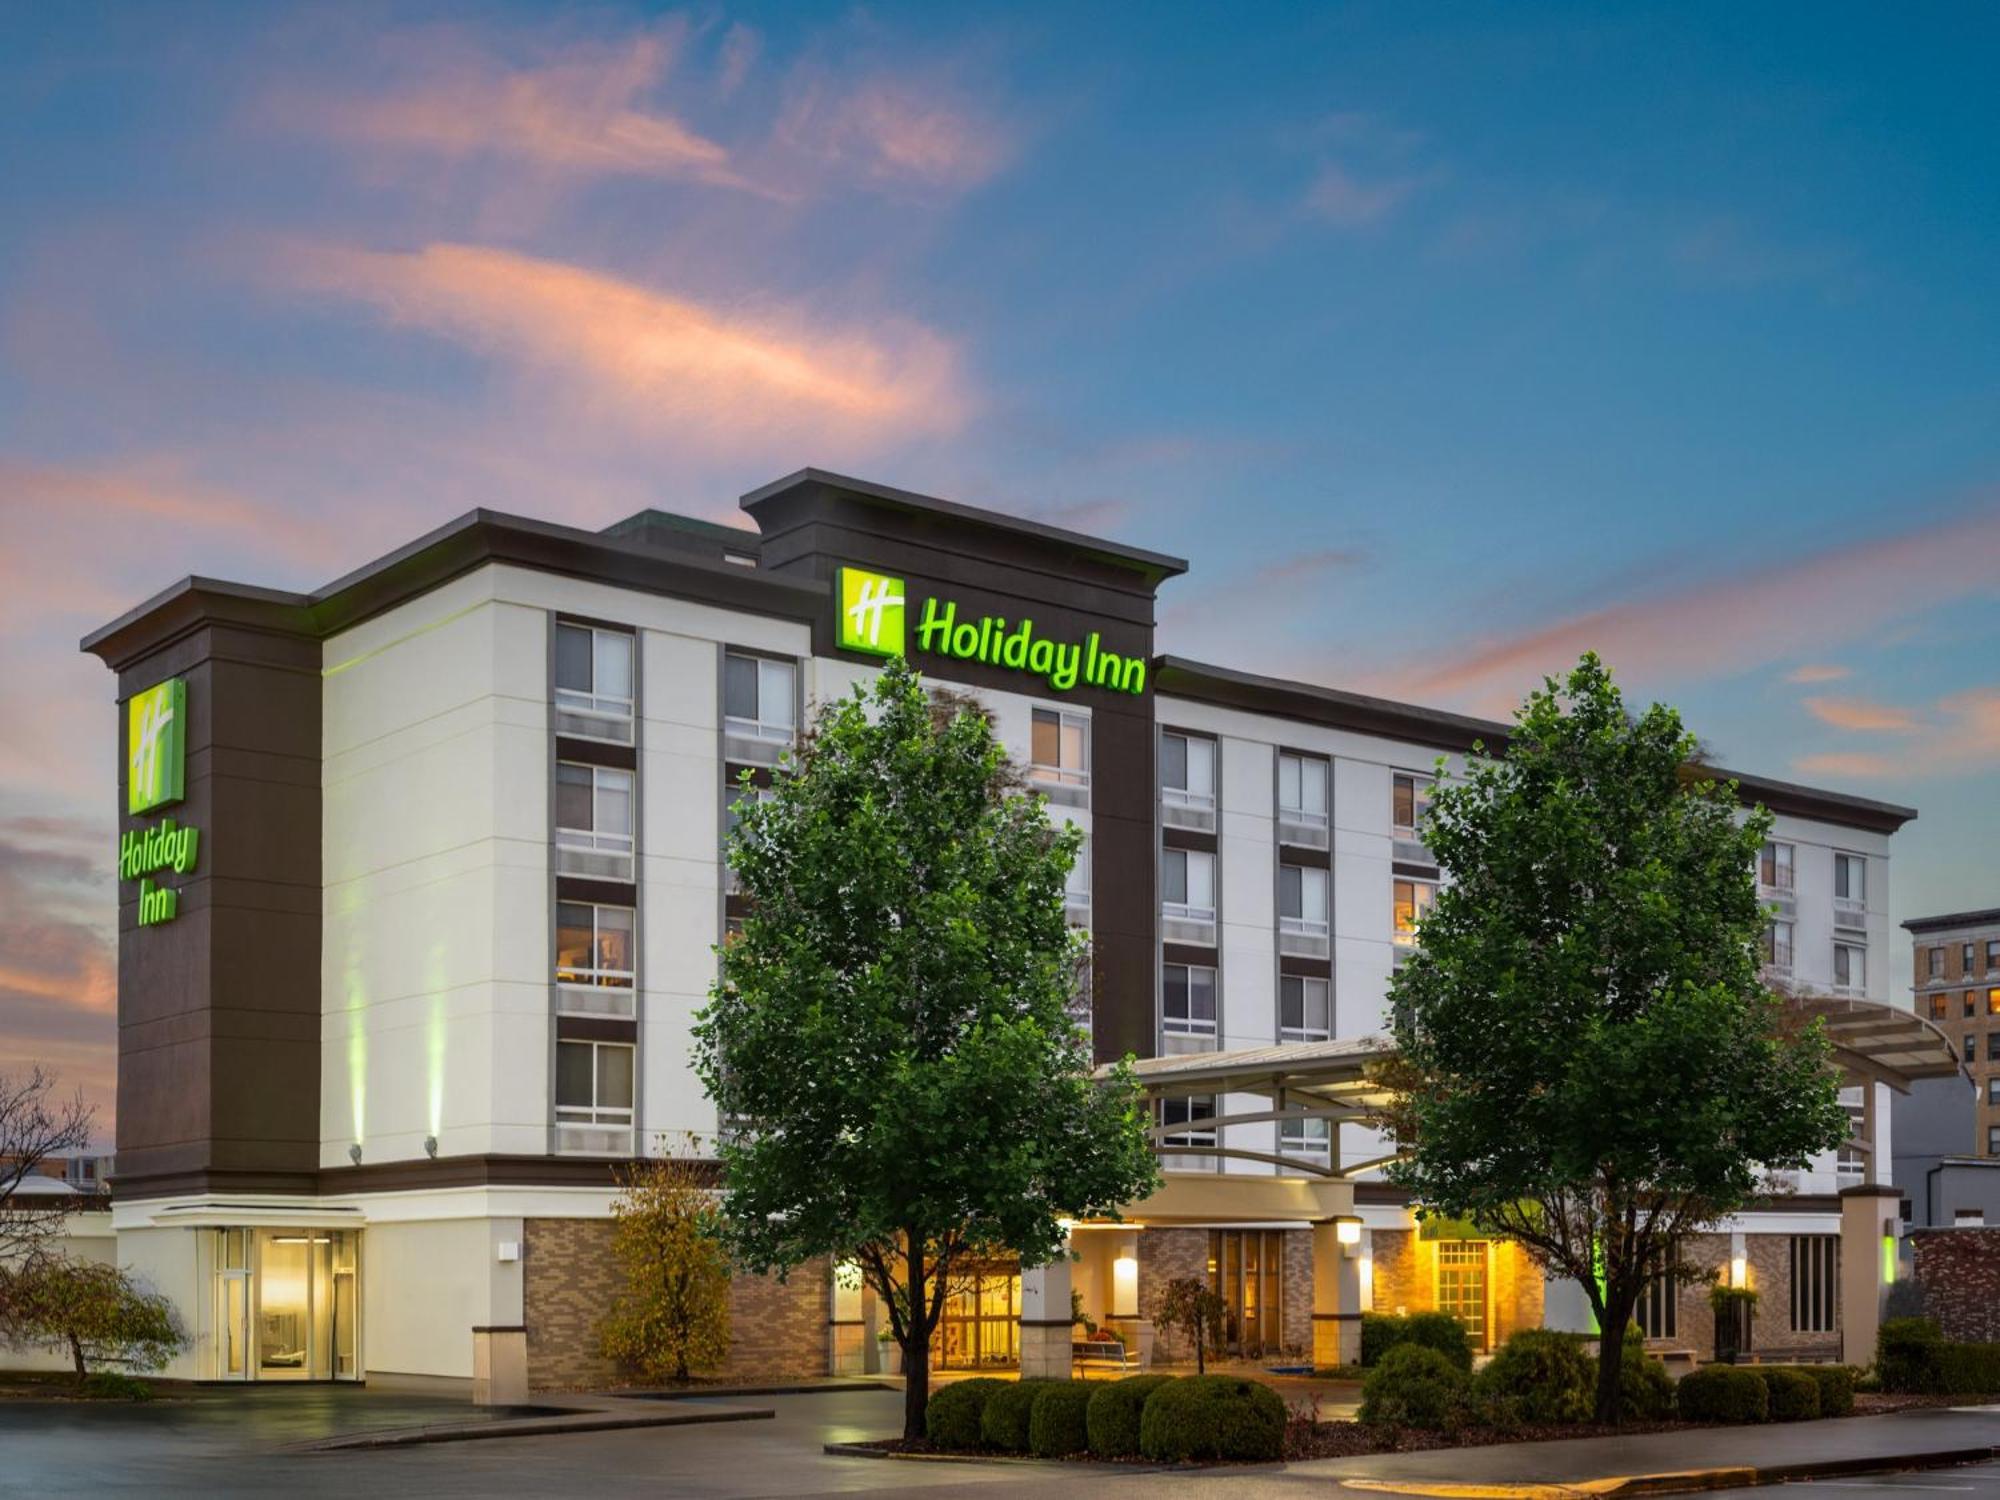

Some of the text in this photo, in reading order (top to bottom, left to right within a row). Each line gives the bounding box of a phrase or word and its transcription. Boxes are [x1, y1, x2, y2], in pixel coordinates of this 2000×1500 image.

[915, 597, 1146, 693] Holiday Inn
[119, 818, 197, 880] Holiday
[138, 877, 175, 926] Inn
